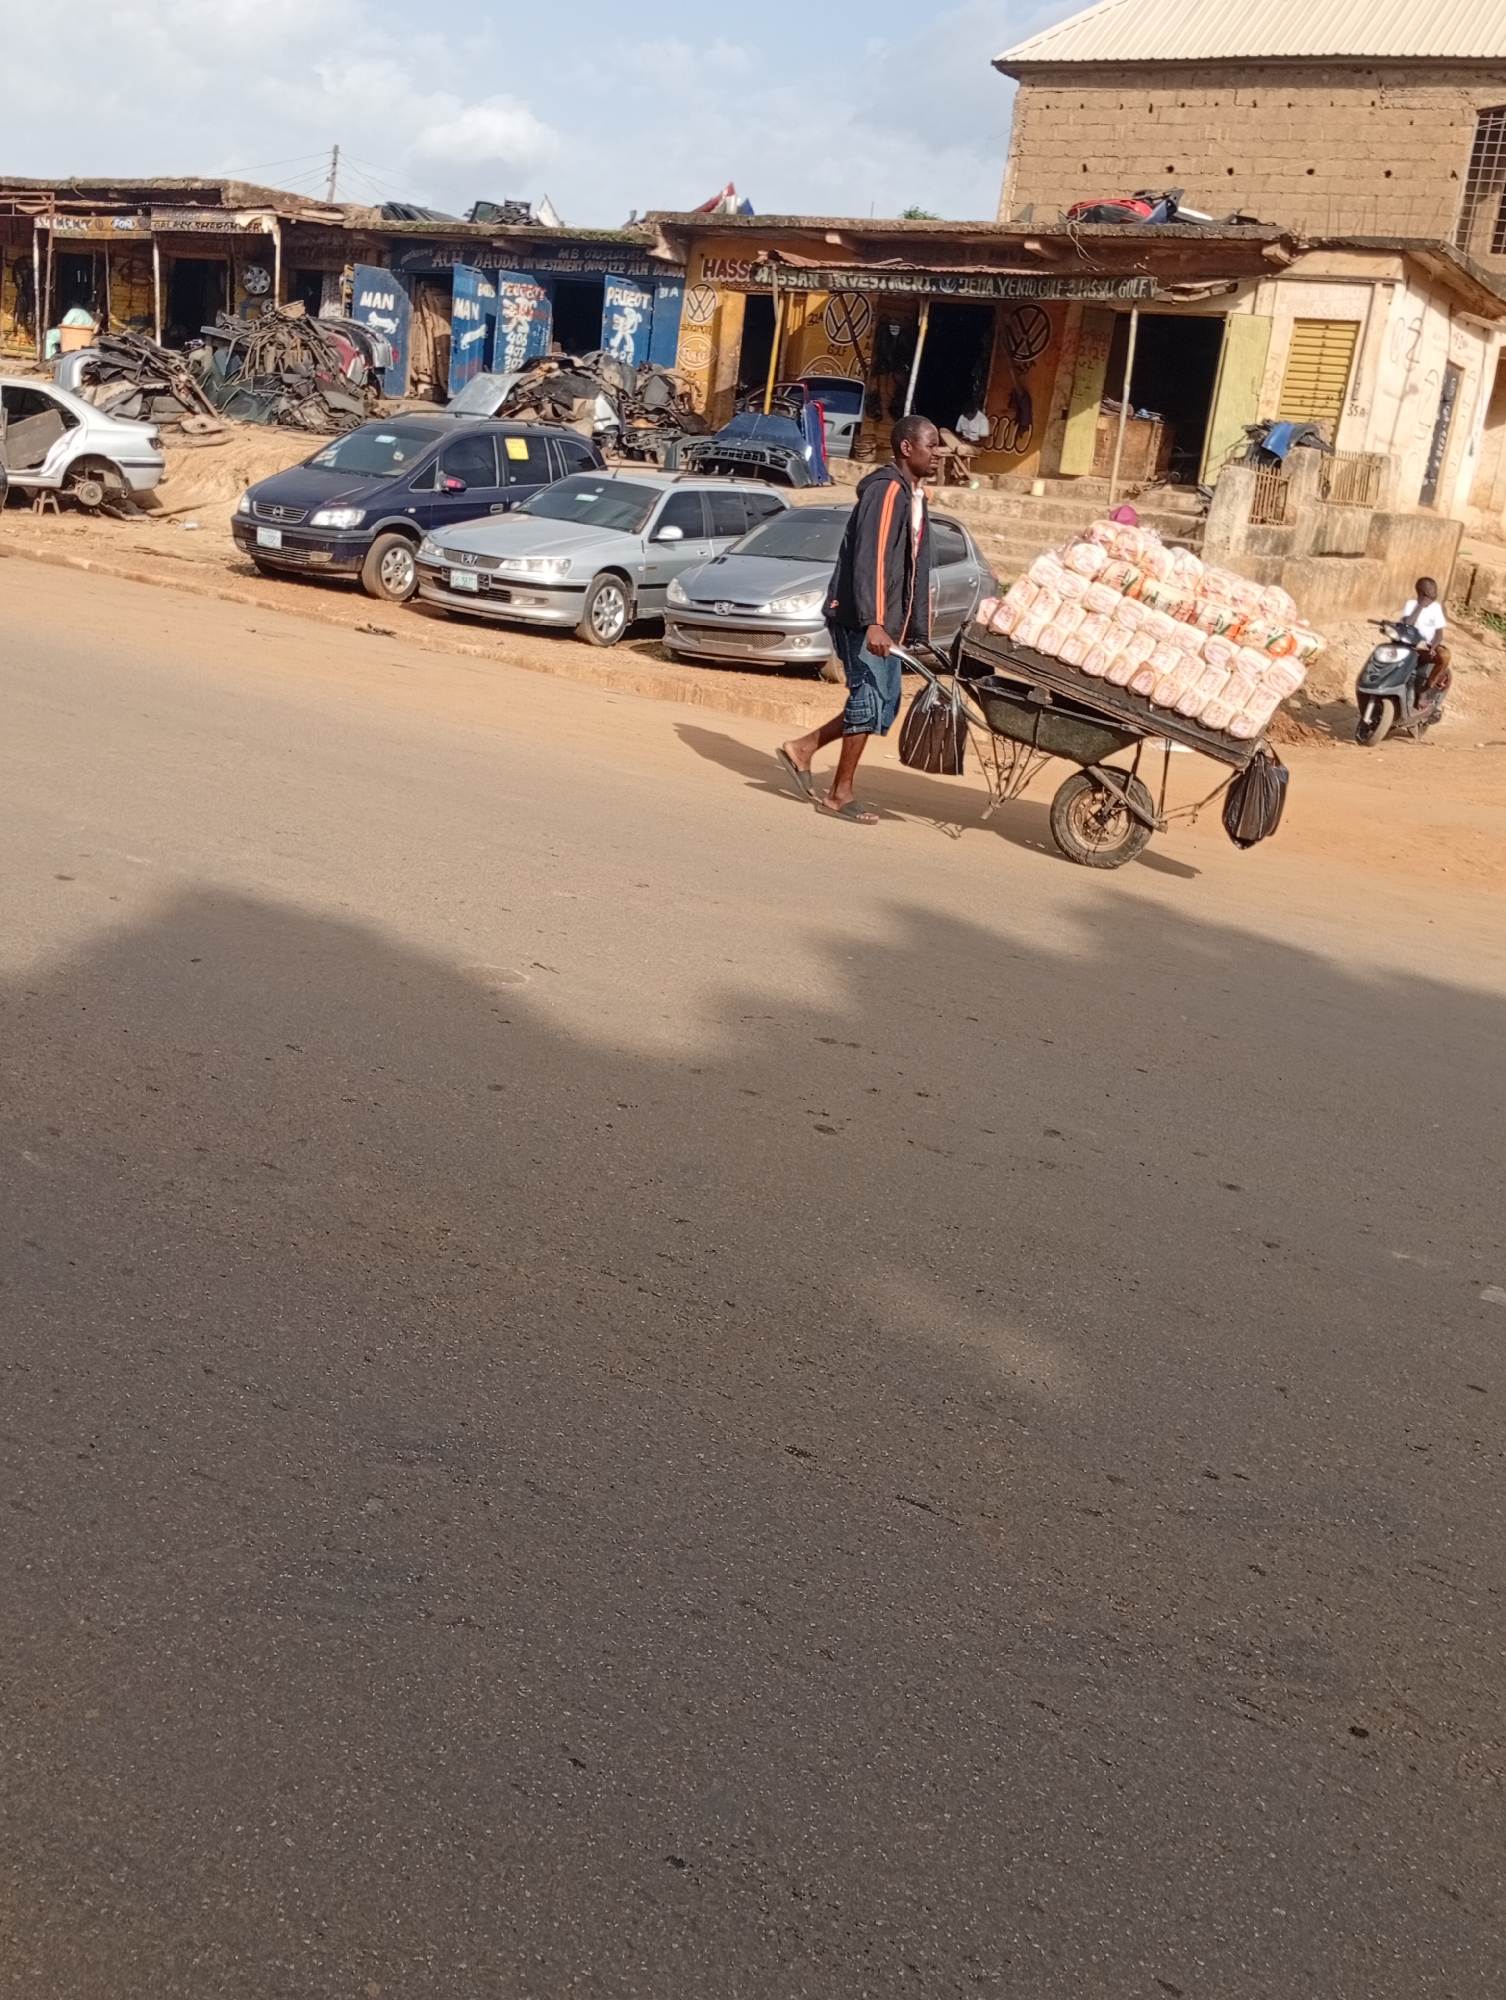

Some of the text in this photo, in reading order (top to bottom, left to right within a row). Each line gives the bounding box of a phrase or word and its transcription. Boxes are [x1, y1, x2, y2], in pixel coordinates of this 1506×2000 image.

[431, 250, 464, 268] ALH
[472, 251, 520, 270] DAUDA
[700, 258, 751, 282] HASS
[359, 290, 395, 312] MAN
[453, 297, 480, 321] MAN
[505, 332, 528, 347] 406
[504, 345, 526, 357] 407
[827, 343, 848, 357] GOLF
